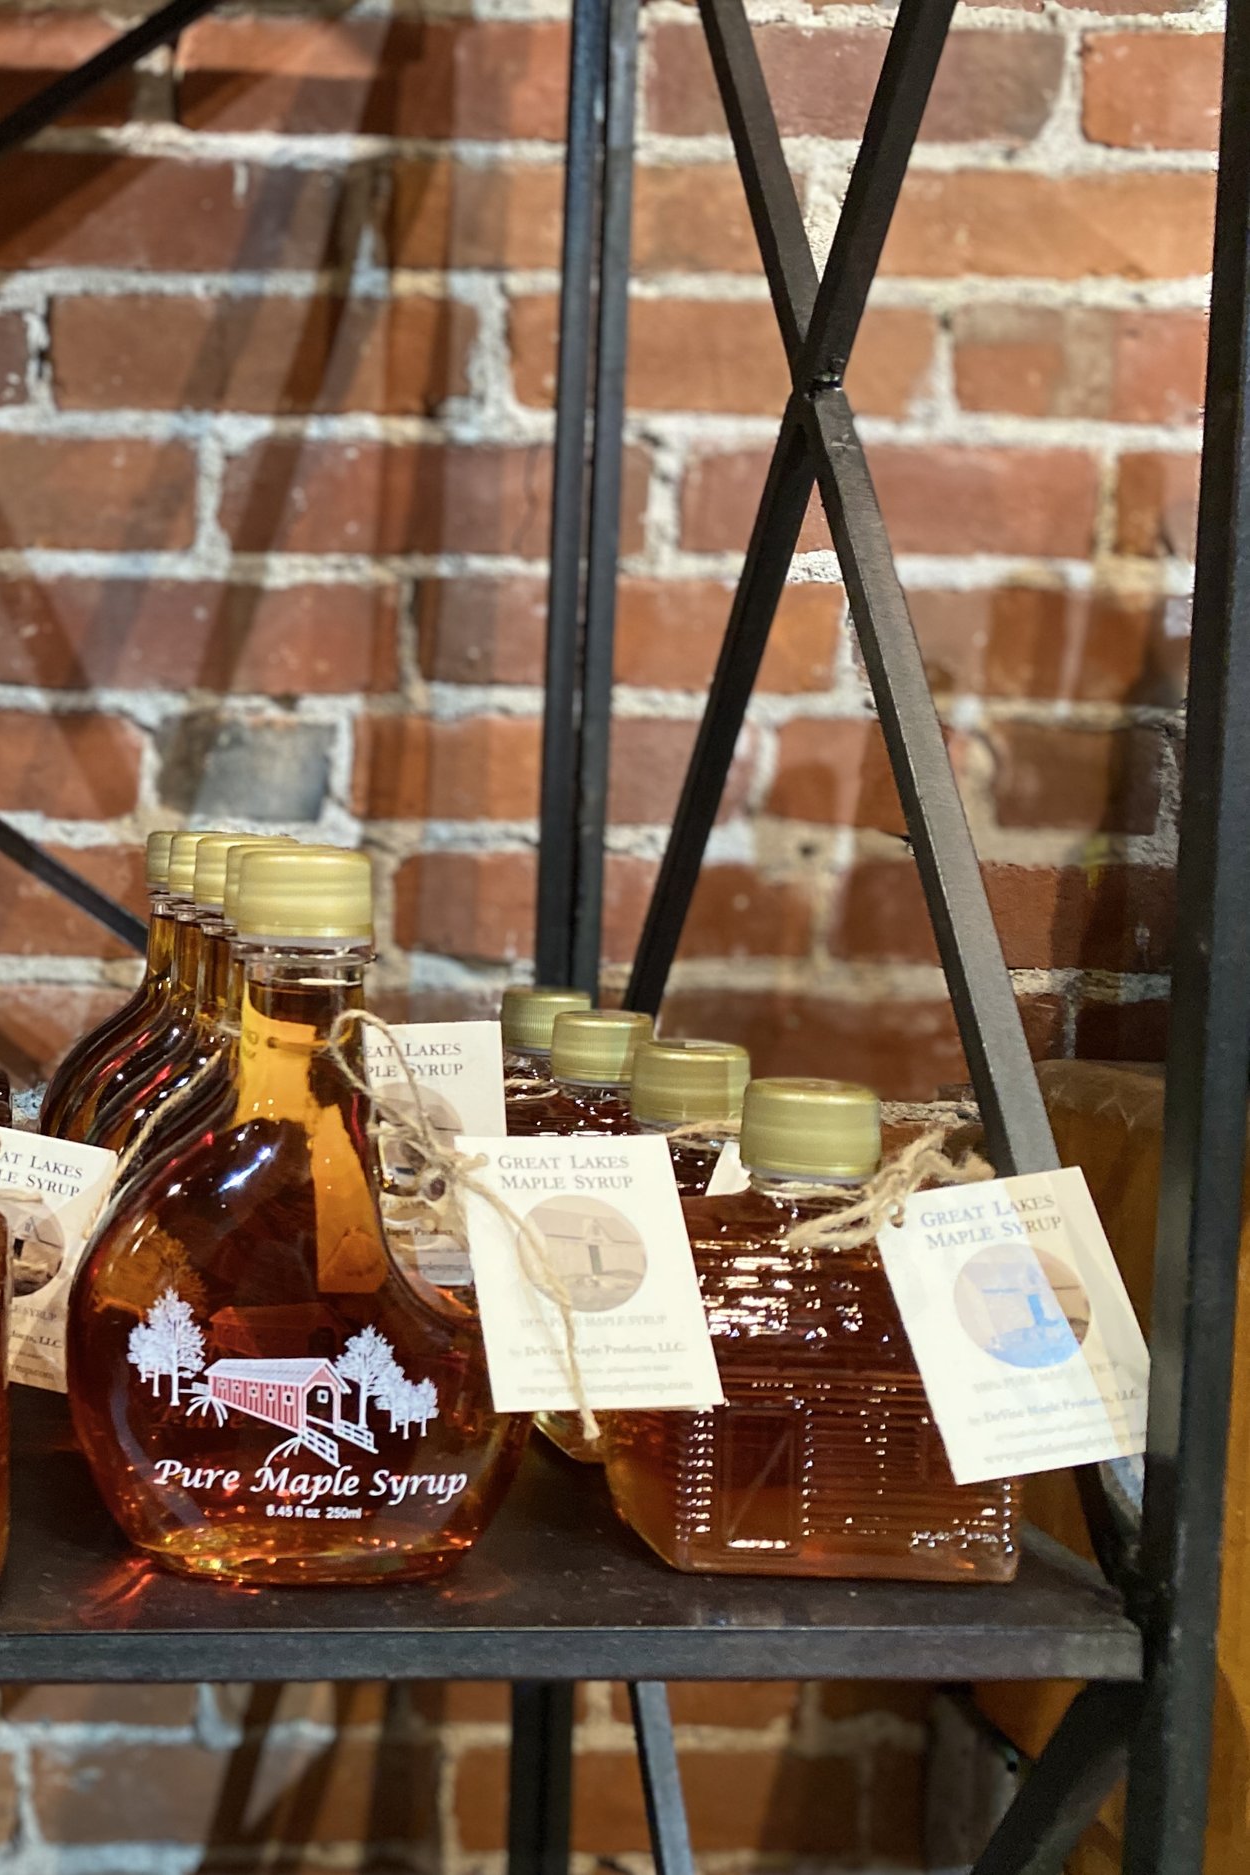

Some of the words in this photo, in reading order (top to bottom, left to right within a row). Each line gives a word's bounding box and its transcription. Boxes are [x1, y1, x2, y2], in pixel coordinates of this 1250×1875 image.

[405, 1043, 462, 1057] LAKES
[30, 1155, 83, 1179] LAKES
[498, 1154, 561, 1170] GREAT
[571, 1154, 630, 1169] LAKES
[25, 1173, 80, 1197] SYRUP
[501, 1175, 566, 1190] MAPLE
[574, 1175, 633, 1191] SYRUP
[921, 1205, 985, 1228] GREAT
[994, 1195, 1056, 1217] LAKES
[924, 1228, 995, 1250] MAPLE
[1002, 1215, 1062, 1237] SYRUP
[153, 1459, 241, 1491] Pure
[250, 1465, 361, 1505] Maple
[368, 1469, 468, 1505] Syrup
